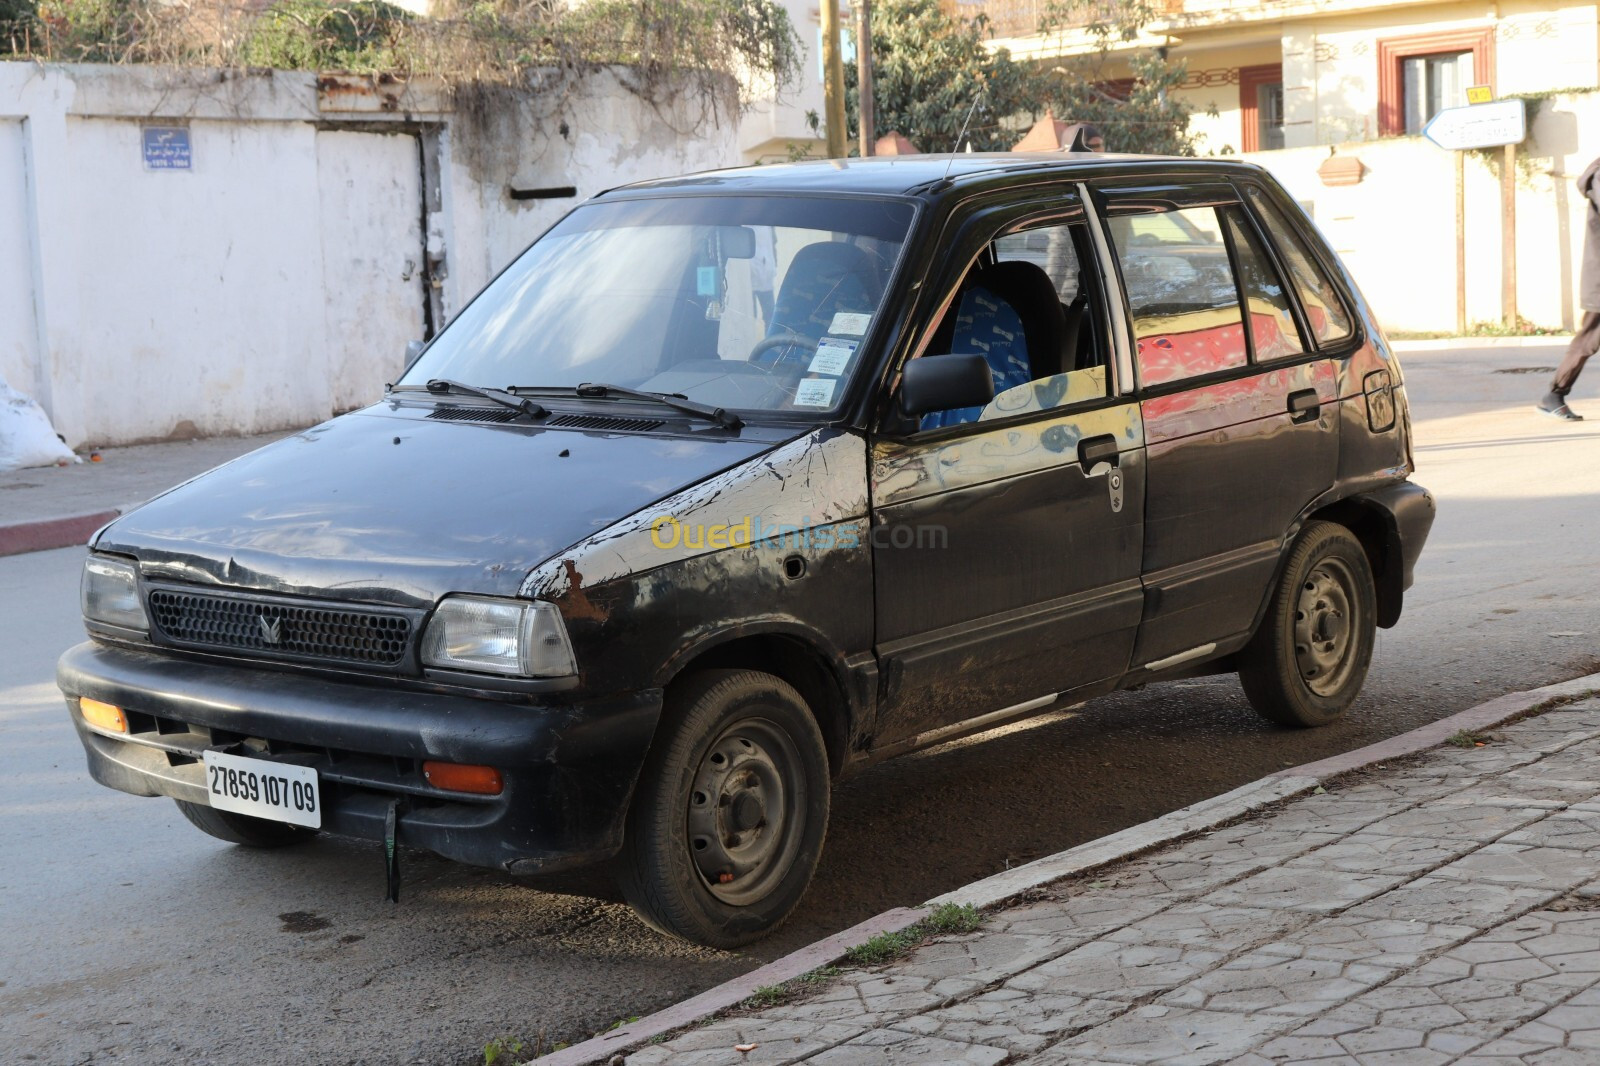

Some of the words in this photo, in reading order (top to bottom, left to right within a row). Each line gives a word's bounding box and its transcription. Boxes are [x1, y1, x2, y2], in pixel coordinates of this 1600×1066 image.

[209, 765, 260, 802] 27859
[261, 774, 289, 808] 107
[293, 780, 316, 813] 09
